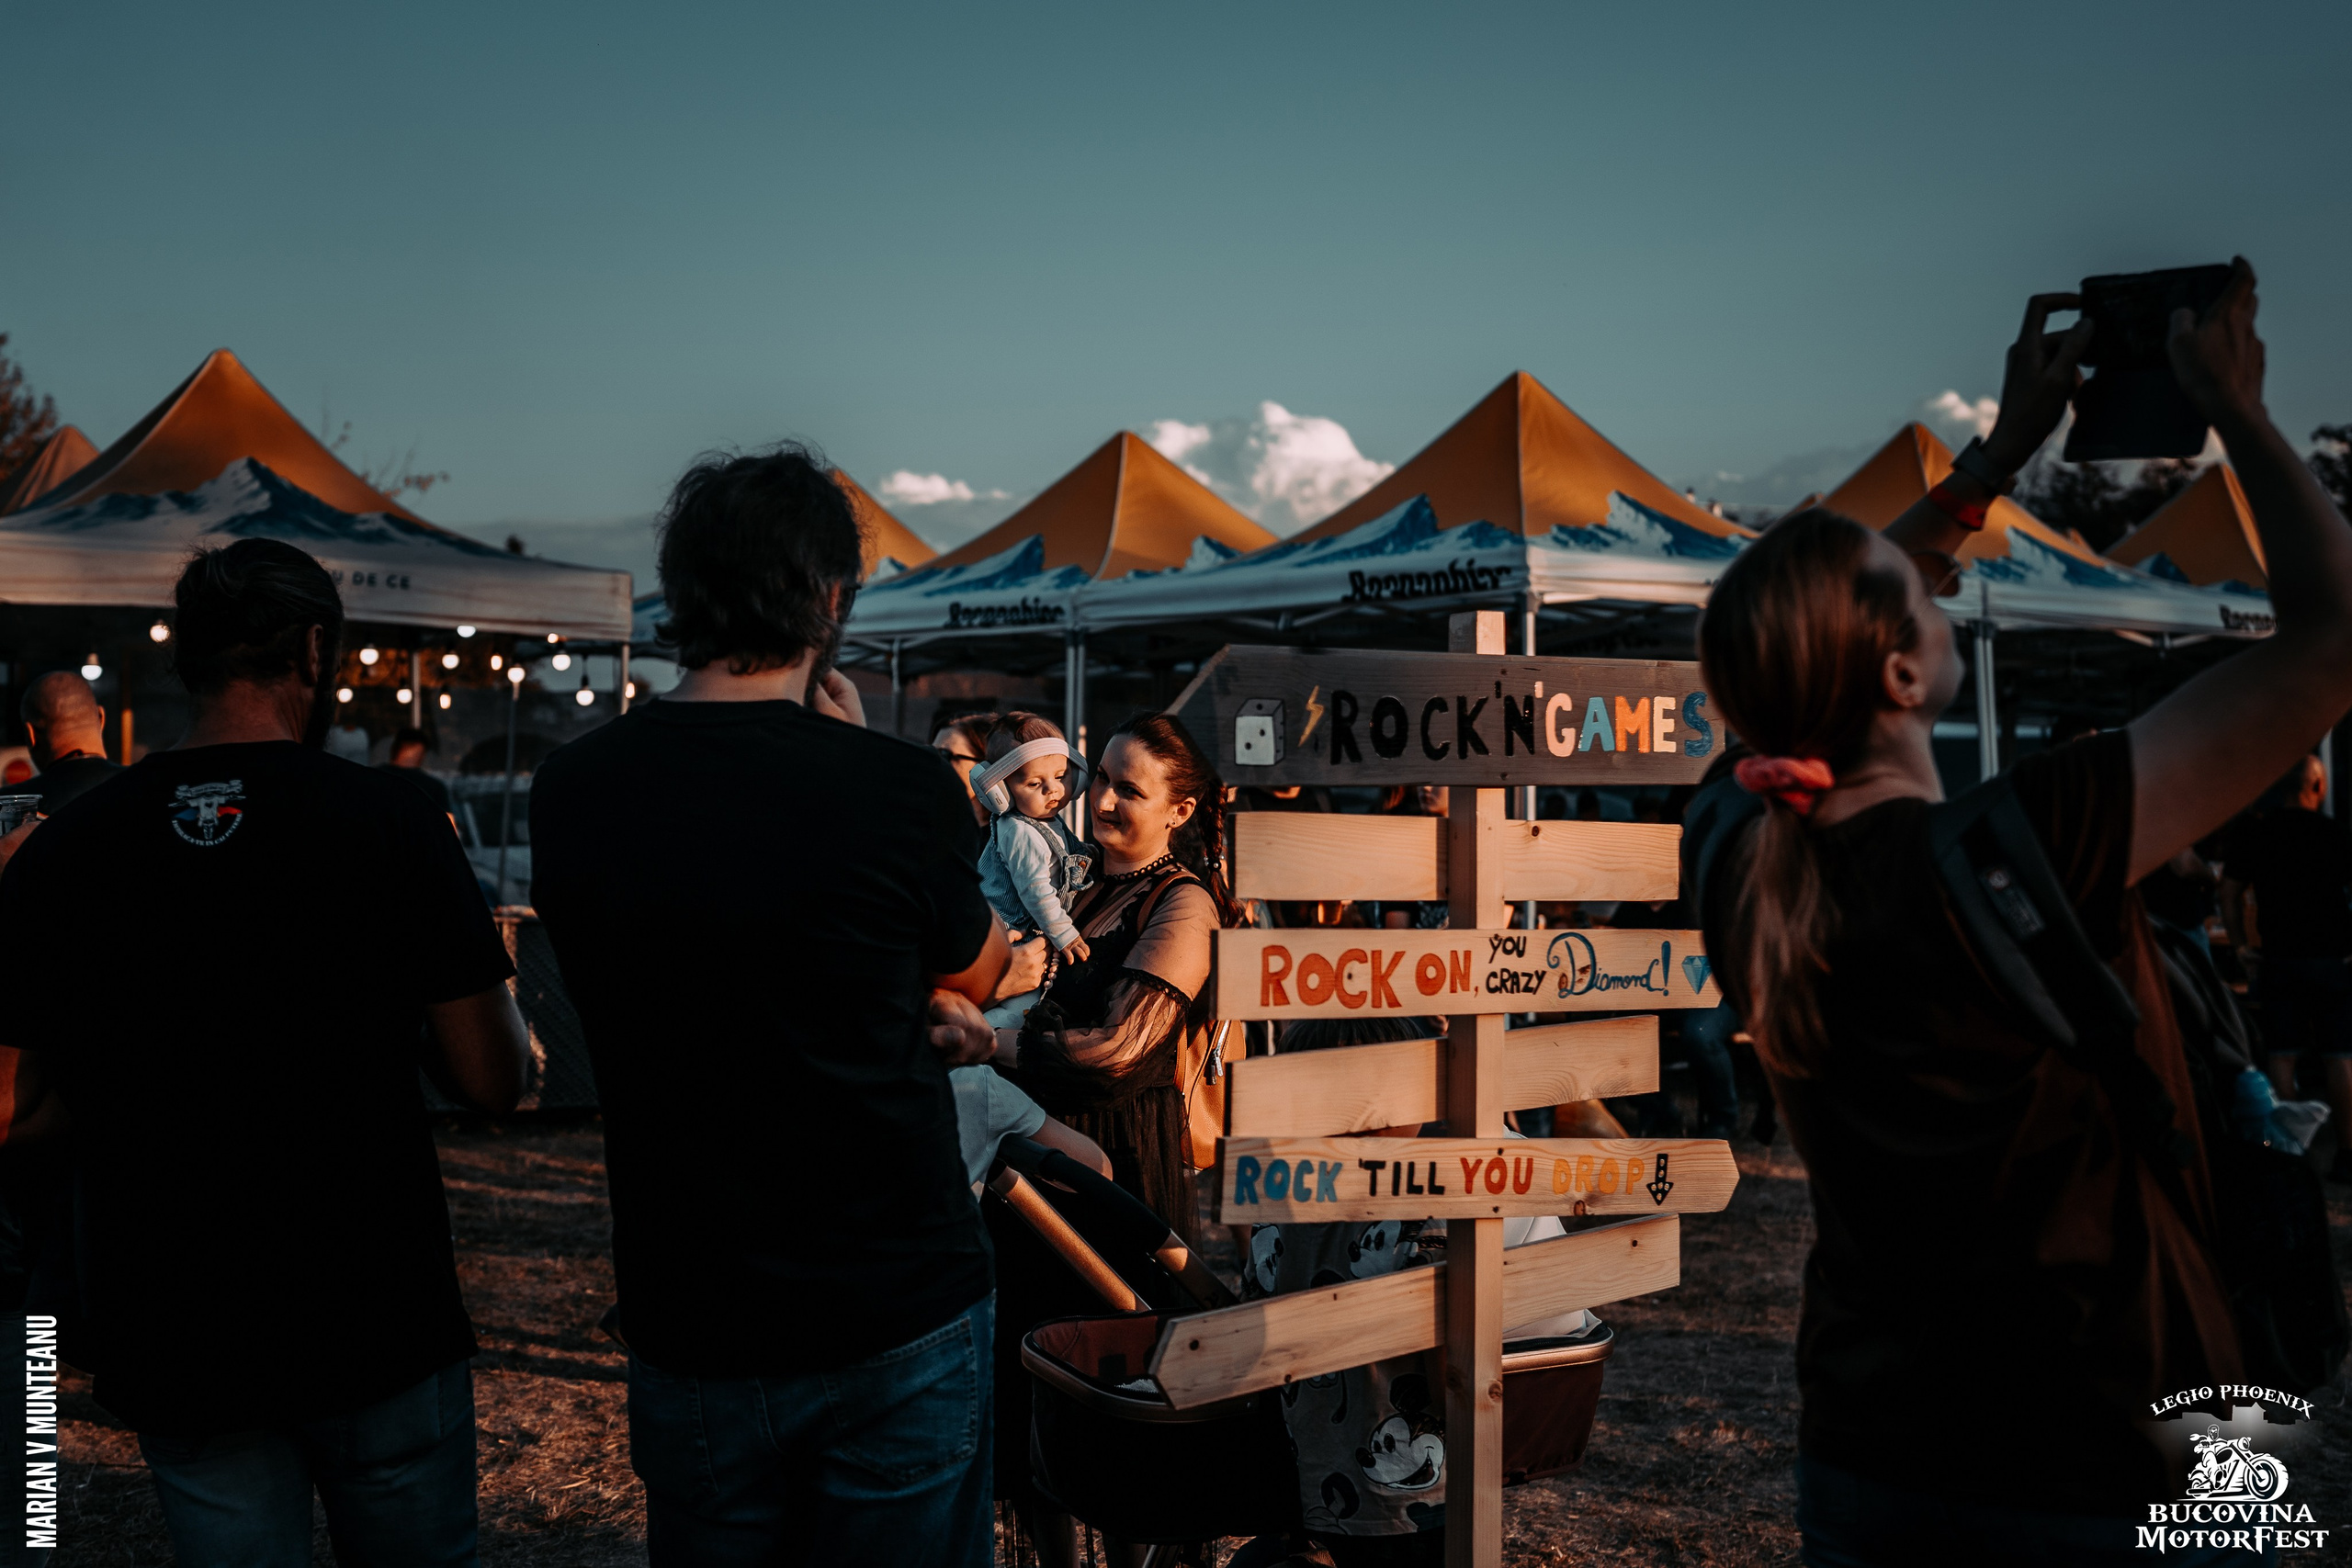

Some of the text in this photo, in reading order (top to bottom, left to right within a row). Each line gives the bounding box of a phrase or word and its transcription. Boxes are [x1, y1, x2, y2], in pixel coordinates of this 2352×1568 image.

[352, 570, 377, 587] DE
[386, 574, 411, 590] CE
[1488, 935, 1527, 964] YOU
[1546, 931, 1672, 998] Diamond!
[1260, 944, 1406, 1009] ROCK
[1485, 967, 1547, 995] CRAZY
[1233, 1156, 1343, 1205] ROCK
[1460, 1156, 1533, 1195] YOU
[1552, 1155, 1645, 1195] DROP
